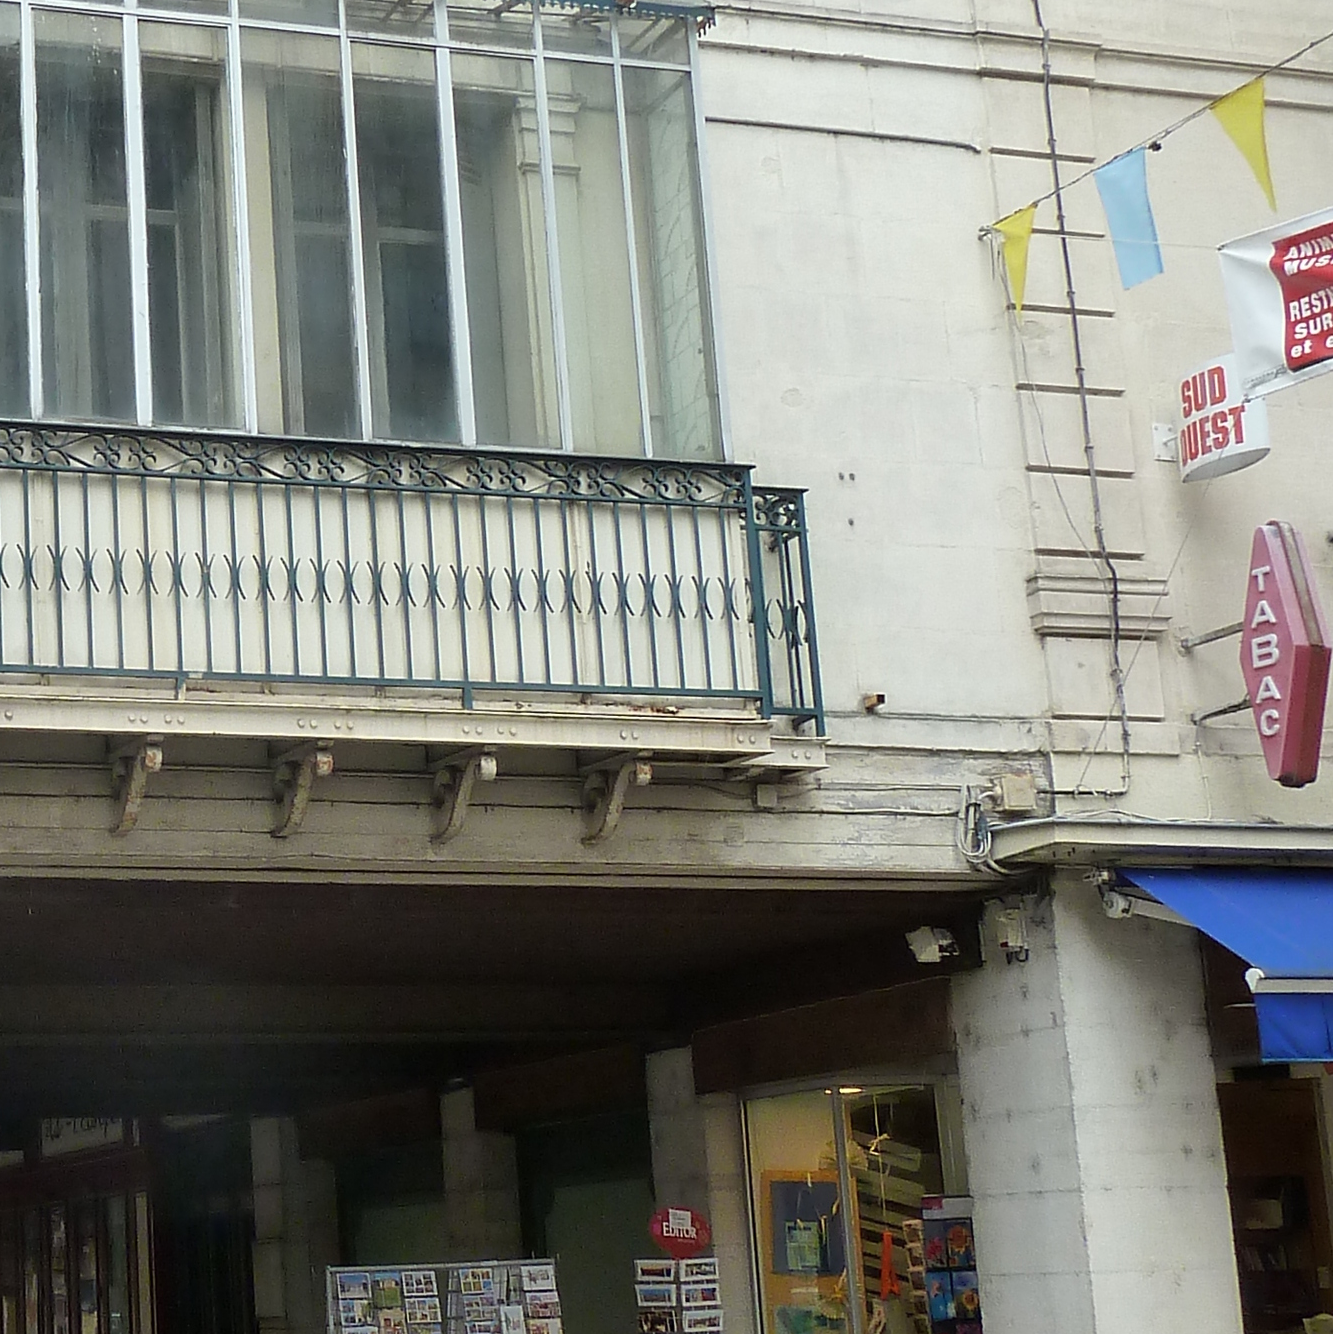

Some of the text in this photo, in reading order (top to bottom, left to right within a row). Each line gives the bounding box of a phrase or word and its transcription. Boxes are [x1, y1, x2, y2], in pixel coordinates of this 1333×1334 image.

[1283, 254, 1333, 277] MUS
[1291, 340, 1313, 358] et
[1181, 366, 1227, 419] SUD
[1251, 565, 1281, 737] TABAC
